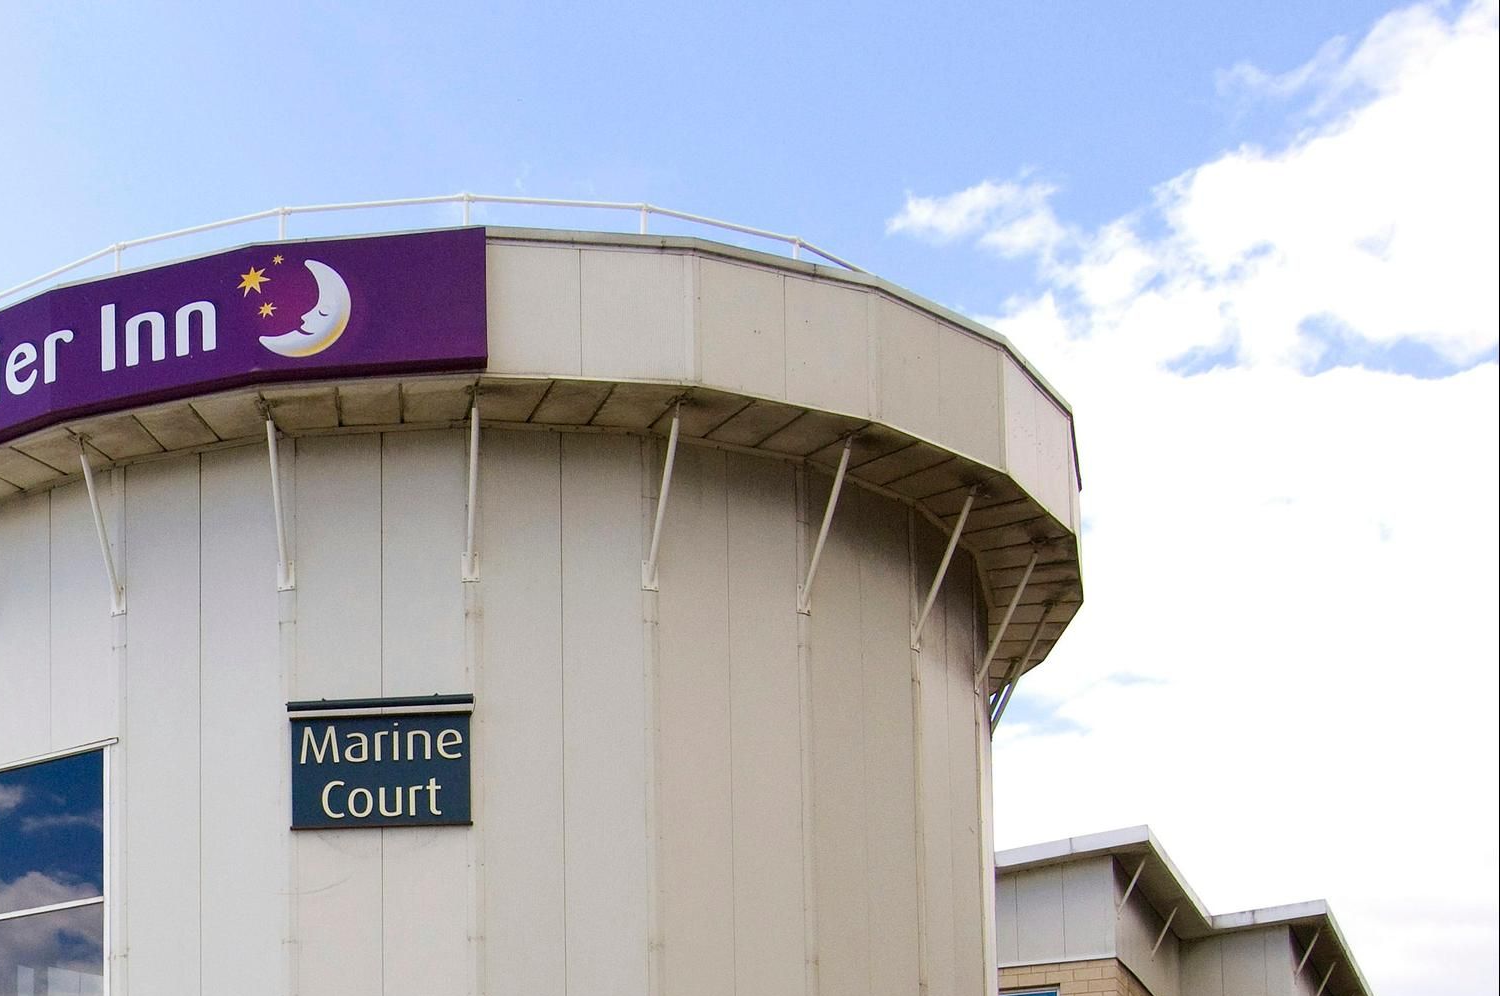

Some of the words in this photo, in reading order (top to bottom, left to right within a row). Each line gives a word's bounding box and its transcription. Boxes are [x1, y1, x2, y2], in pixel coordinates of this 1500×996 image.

[100, 300, 217, 373] Inn
[300, 722, 463, 765] Marine
[321, 777, 443, 819] Court
